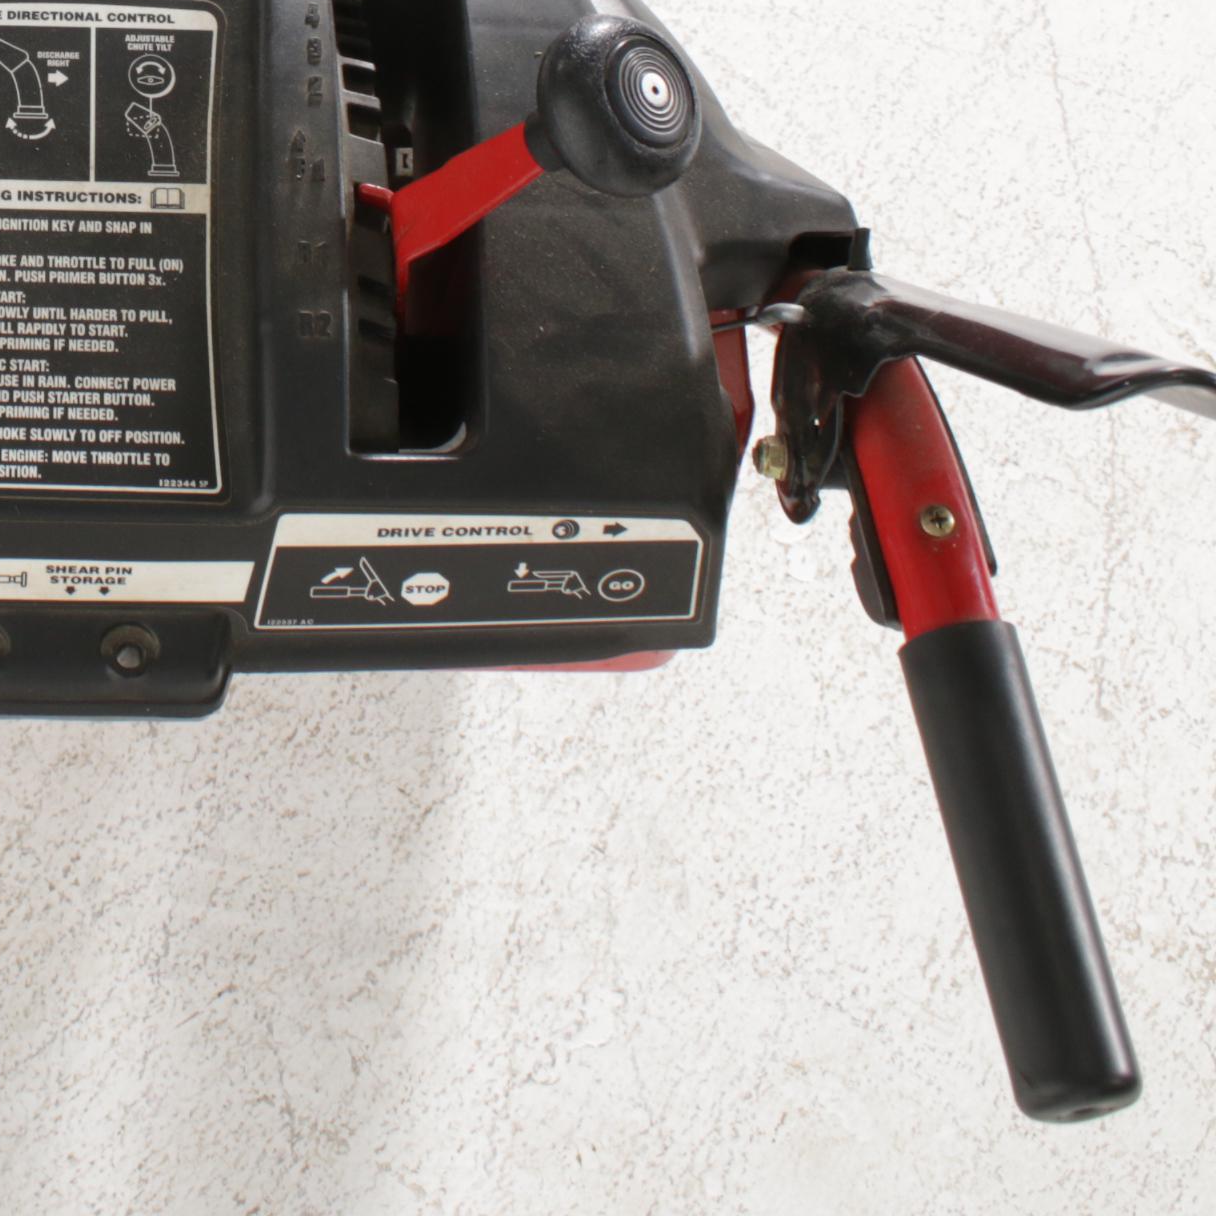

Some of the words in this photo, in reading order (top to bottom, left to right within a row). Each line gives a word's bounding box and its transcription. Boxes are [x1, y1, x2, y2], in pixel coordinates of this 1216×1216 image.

[8, 11, 102, 22] DIRECTIONAL
[107, 12, 175, 23] CONTROL
[125, 34, 175, 43] ADJUSTABLE
[128, 42, 152, 50] CHUTE
[156, 43, 172, 51] TILT
[37, 51, 79, 59] DISCHARGE
[47, 59, 70, 67] RIGHT
[18, 191, 142, 204] INSTRUCTIONS:
[52, 221, 75, 231] KEY
[79, 221, 101, 232] AND
[106, 222, 136, 233] SNAP
[140, 223, 152, 234] IN
[20, 256, 44, 267] AND
[48, 256, 106, 269] THROTTLE
[110, 258, 125, 269] TO
[128, 259, 156, 270] FULL
[159, 259, 183, 272] (ON)
[15, 271, 45, 282] PUSH
[49, 272, 95, 284] PRIMER
[99, 273, 145, 285] BUTTON
[148, 275, 166, 286] 3x.
[33, 307, 66, 320] UNTIL
[70, 308, 117, 321] HARDER
[121, 310, 135, 322] TO
[18, 323, 67, 335] RAPIDLY
[70, 324, 85, 336] TO
[89, 325, 128, 337] START.
[0, 338, 50, 350] PRIMING
[54, 339, 65, 351] IF
[69, 340, 119, 353] NEEDED.
[10, 359, 49, 372] START:
[23, 376, 34, 387] IN
[38, 376, 70, 388] RAIN.
[75, 377, 129, 390] CONNECT
[133, 379, 176, 391] POWER
[13, 391, 44, 403] PUSH
[48, 392, 100, 404] STARTER
[104, 393, 154, 406] BUTTON.
[53, 408, 65, 420] IF
[68, 408, 118, 422] NEEDED.
[30, 429, 76, 442] SLOWLY
[80, 430, 96, 442] TO
[99, 430, 122, 442] OFF
[126, 431, 185, 444] POSITION.
[1, 450, 48, 463] ENGINE:
[52, 451, 87, 464] MOVE
[91, 452, 151, 465] THROTTLE
[154, 454, 170, 466] TO
[377, 528, 436, 537] DRIVE
[441, 525, 533, 537] CONTROL
[45, 565, 98, 574] SHEAR
[104, 567, 132, 575] PIN
[50, 575, 127, 585] STORAGE
[609, 581, 634, 590] GO
[405, 584, 446, 594] STOP
